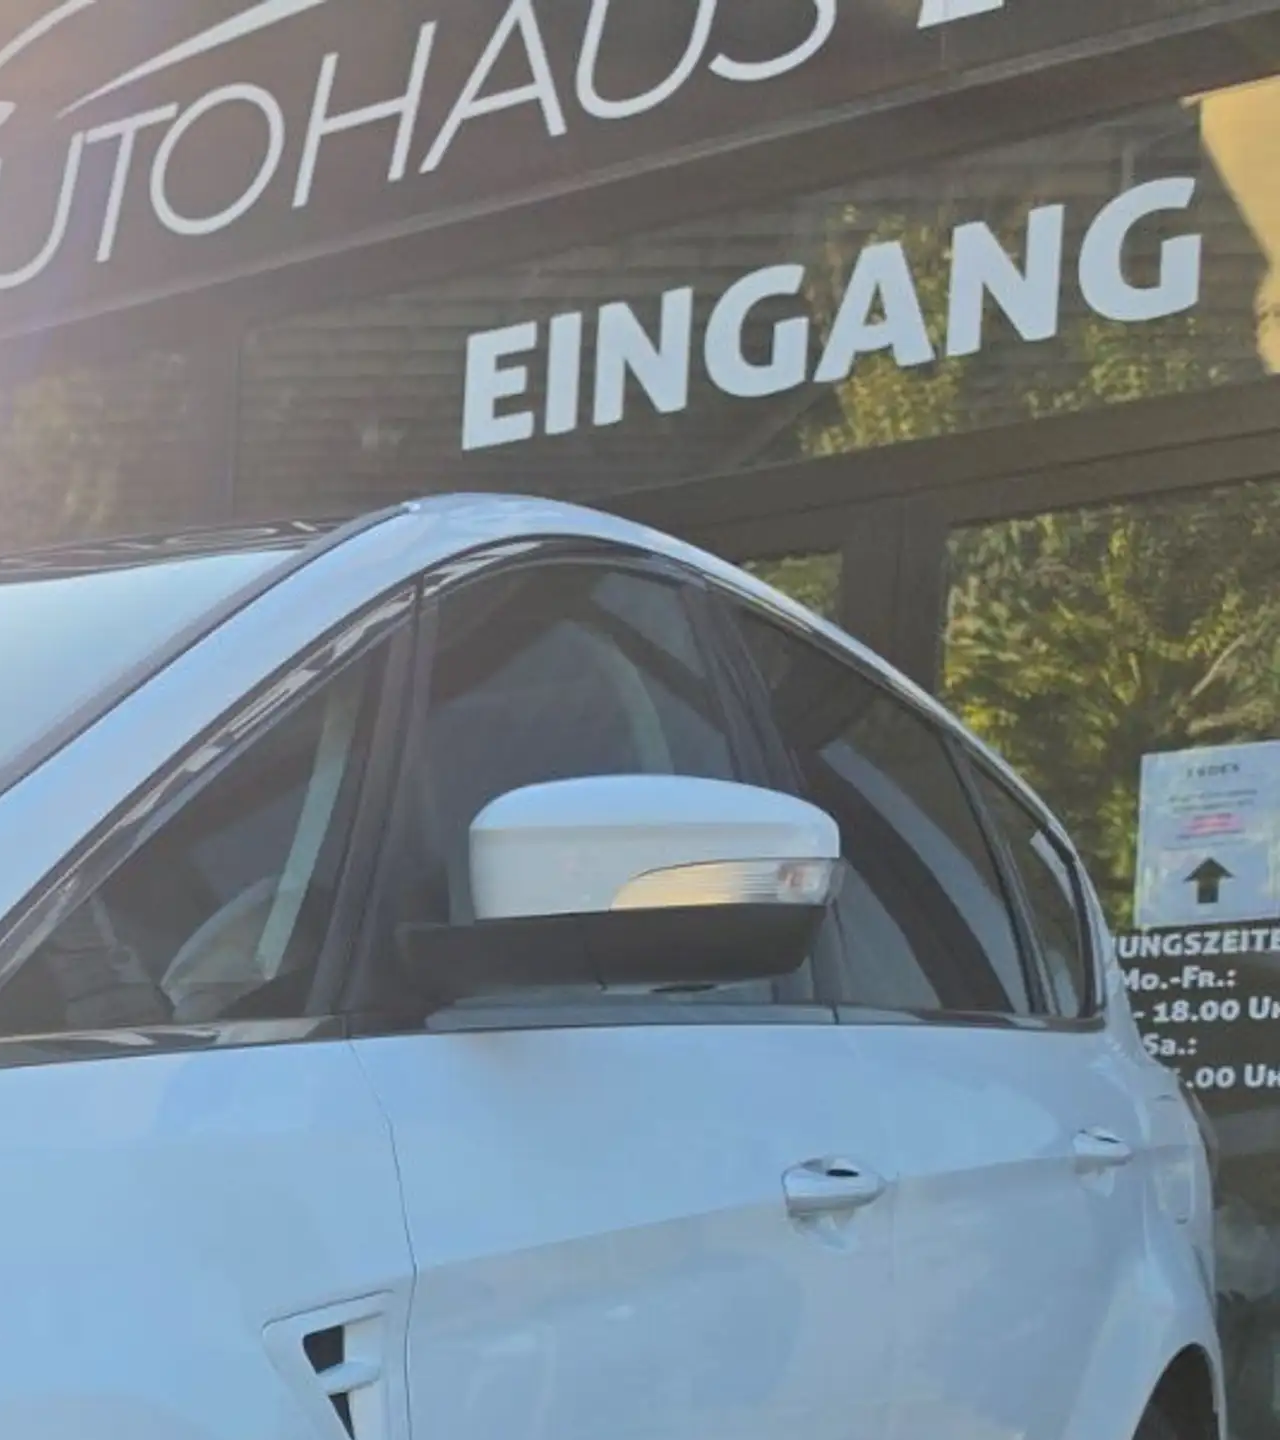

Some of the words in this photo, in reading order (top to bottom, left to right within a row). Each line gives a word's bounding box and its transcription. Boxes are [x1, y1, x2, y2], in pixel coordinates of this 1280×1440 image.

[461, 177, 1202, 449] EINGANG
[1112, 928, 1280, 960] UNGSZEITE
[1153, 1000, 1241, 1024] 18.00
[1175, 1066, 1237, 1090] .00
